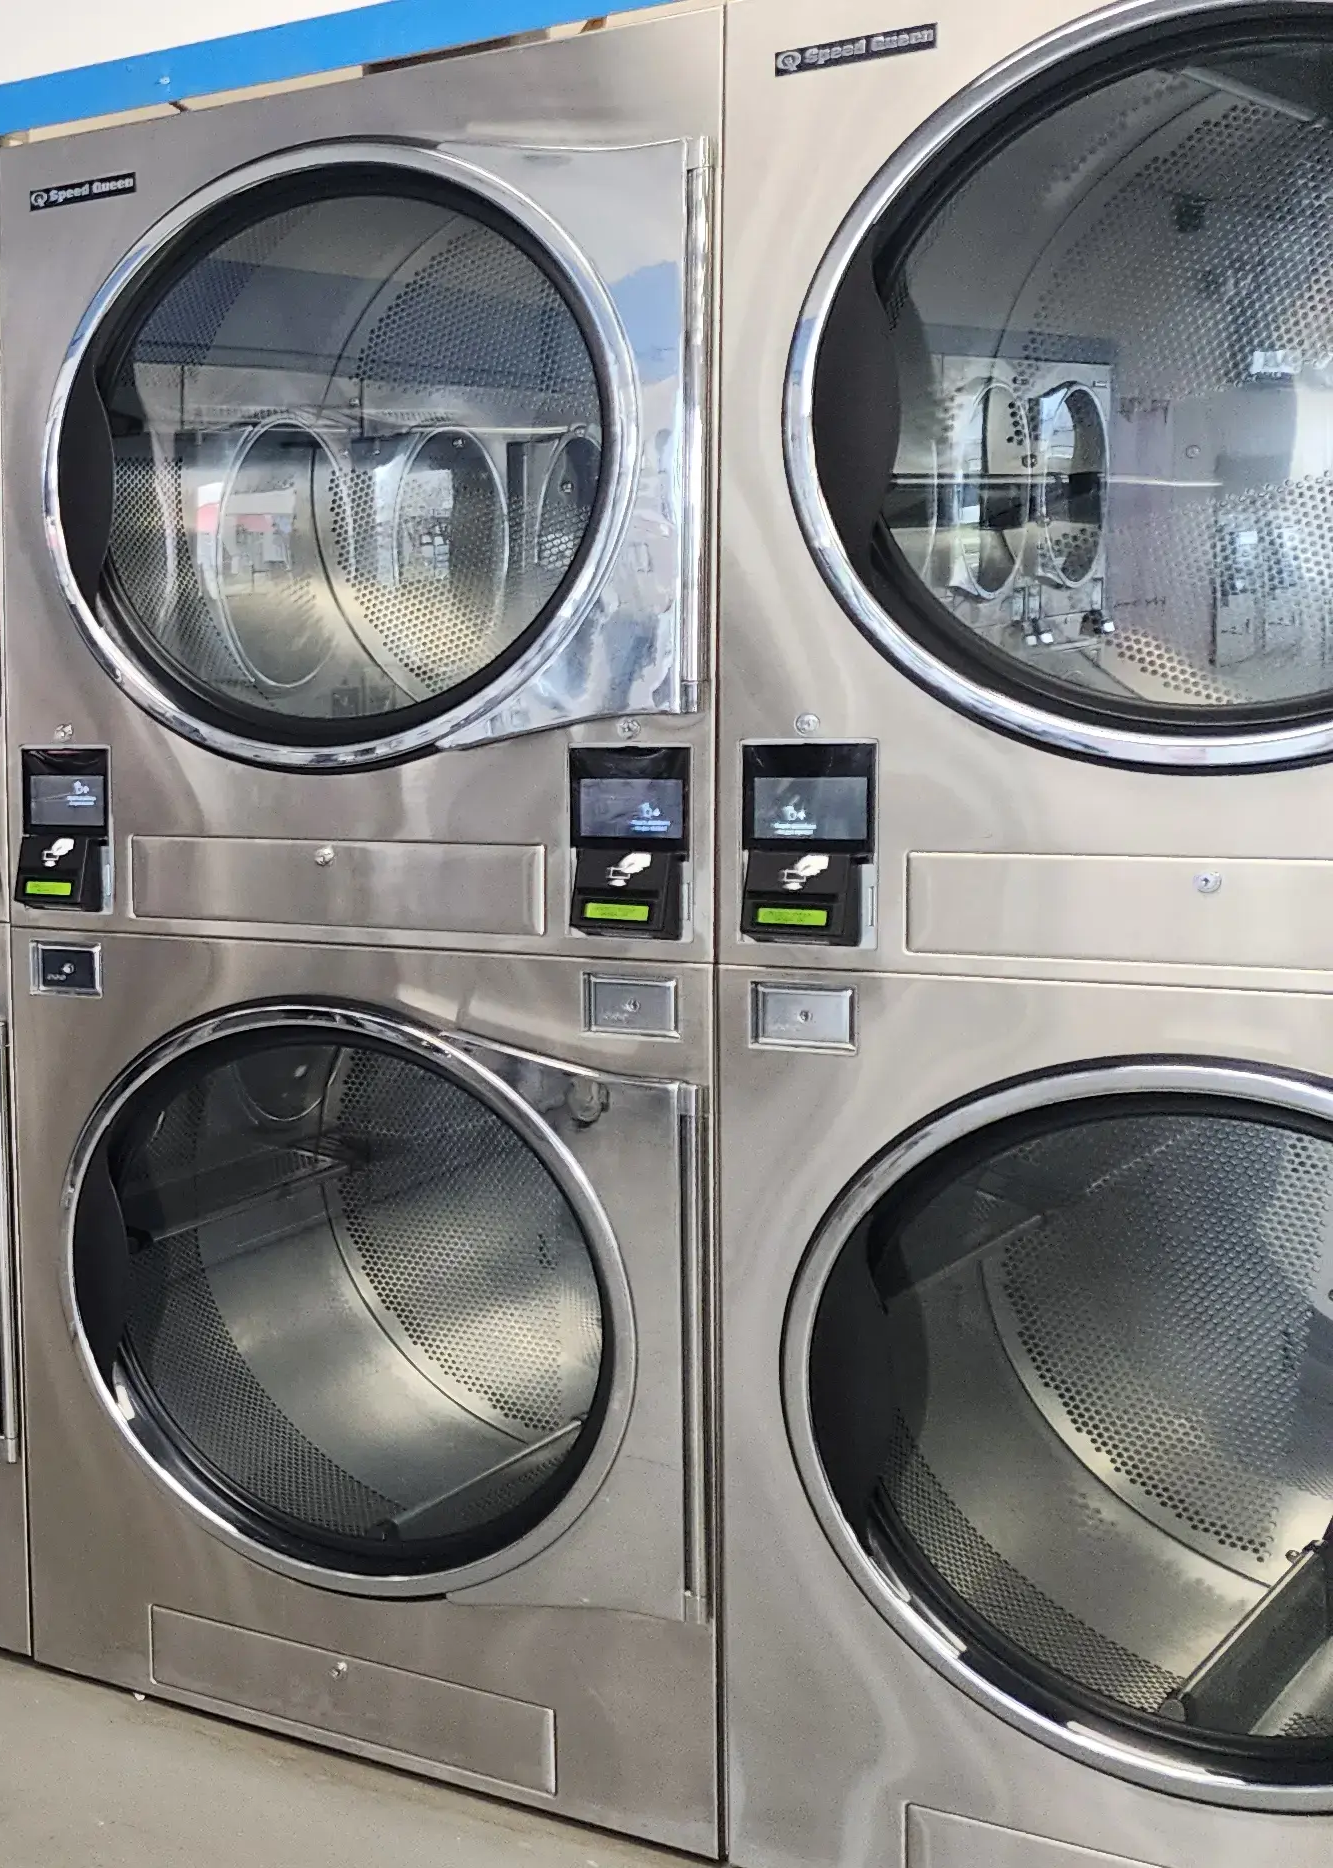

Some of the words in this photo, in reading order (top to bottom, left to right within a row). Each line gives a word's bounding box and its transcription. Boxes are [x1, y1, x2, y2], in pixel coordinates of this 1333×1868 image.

[803, 38, 866, 64] Speed
[870, 29, 934, 52] Queen
[48, 182, 90, 203] Speed
[92, 178, 133, 194] Queen
